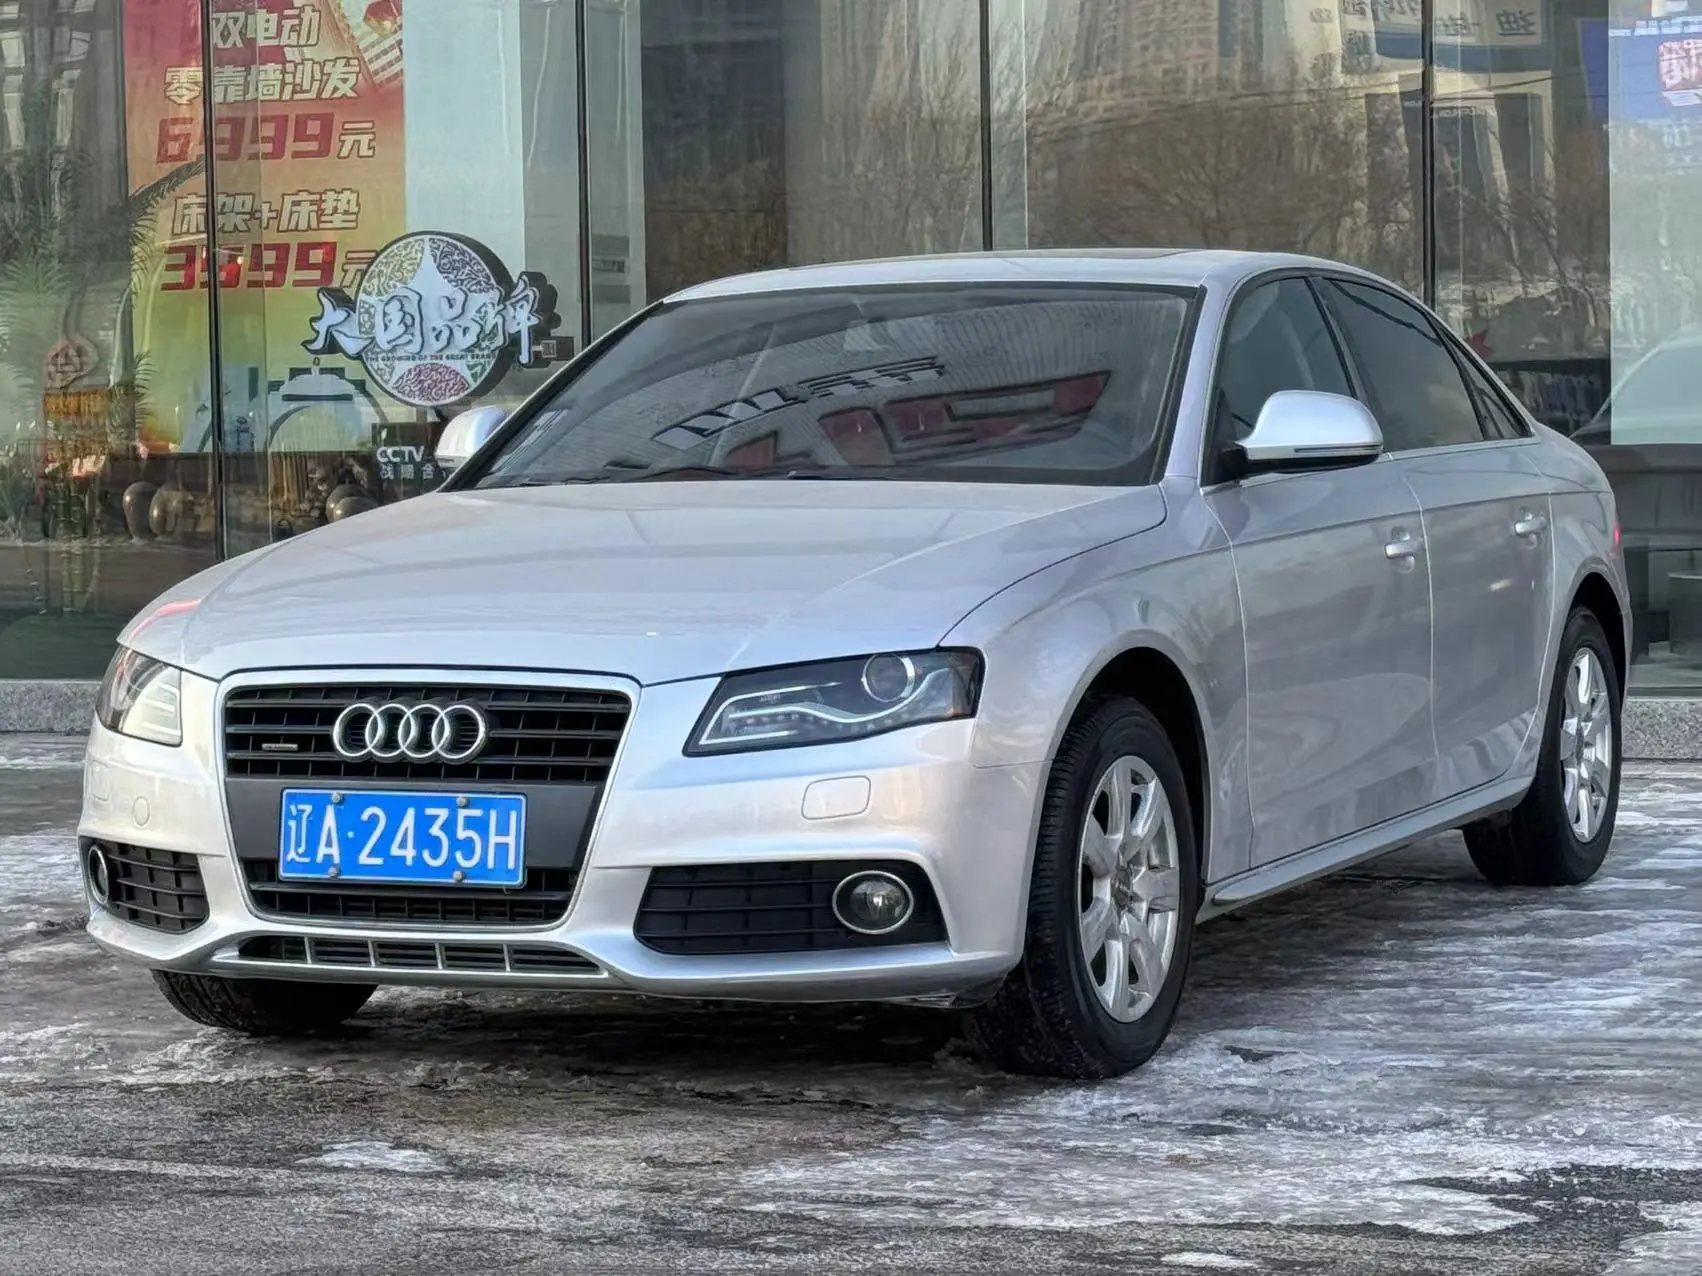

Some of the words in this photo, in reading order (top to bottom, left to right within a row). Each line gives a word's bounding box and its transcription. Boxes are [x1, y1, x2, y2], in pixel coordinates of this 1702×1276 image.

[212, 7, 321, 48] 双电动
[164, 57, 360, 105] 零靠墙沙发
[173, 188, 361, 235] 床架+床垫
[376, 445, 425, 462] CCTV
[287, 803, 517, 869] 辽A·2435H
